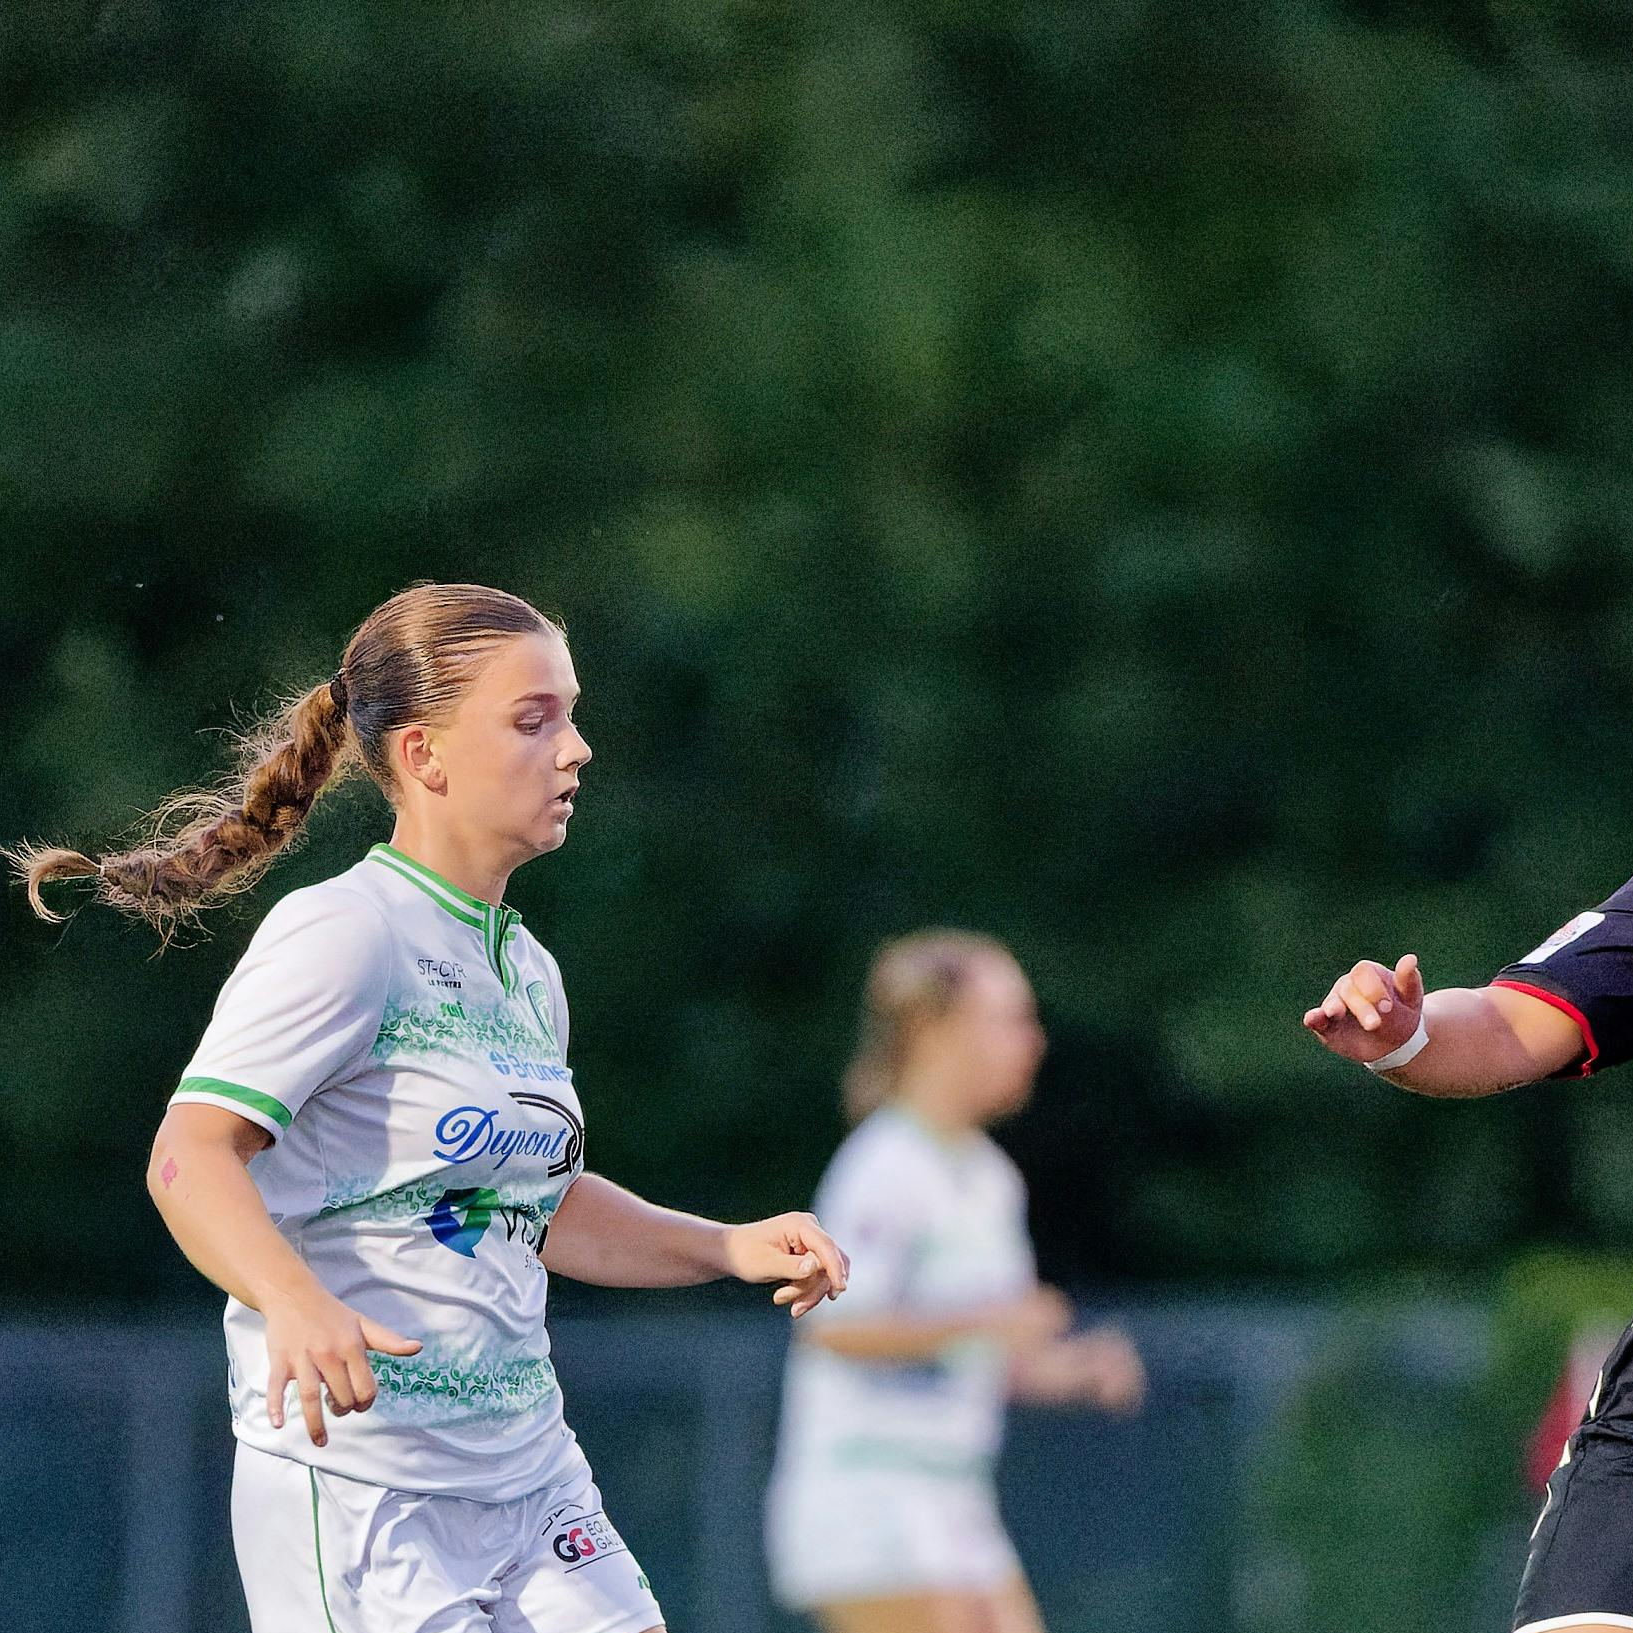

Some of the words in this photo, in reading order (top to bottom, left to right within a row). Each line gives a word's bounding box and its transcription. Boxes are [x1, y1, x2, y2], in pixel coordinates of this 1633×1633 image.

[417, 958, 468, 979] ST-CYR
[507, 1053, 569, 1082] Brune
[433, 1106, 568, 1171] Dupont
